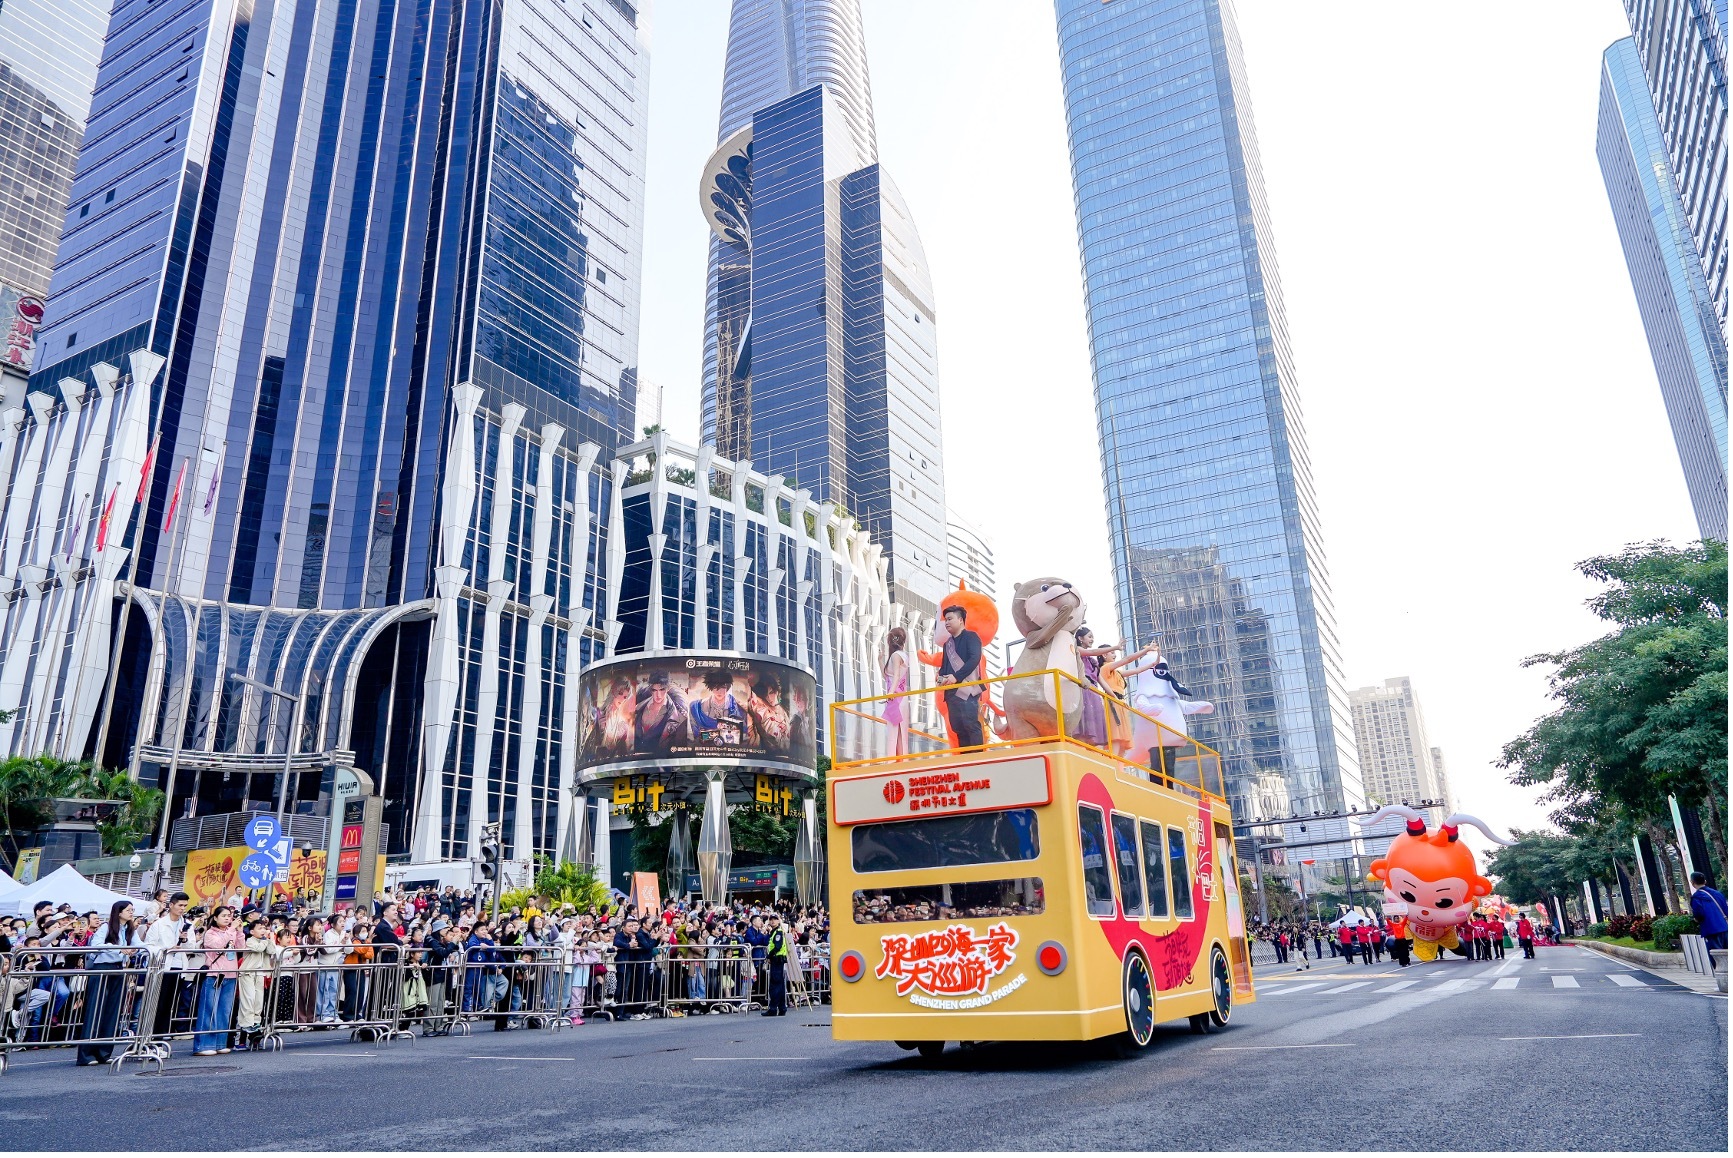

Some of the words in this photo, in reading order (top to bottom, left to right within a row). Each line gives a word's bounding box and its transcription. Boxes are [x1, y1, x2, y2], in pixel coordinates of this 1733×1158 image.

[613, 775, 665, 812] Bit
[756, 775, 792, 816] Bit
[908, 773, 960, 787] SHENZHEN
[908, 784, 952, 798] FESTIVAL
[952, 779, 991, 793] AVENUE
[898, 956, 993, 994] 大巡游
[909, 993, 958, 1010] SHENZHEN
[958, 995, 993, 1010] GRAND
[991, 973, 1028, 1001] PARADE
